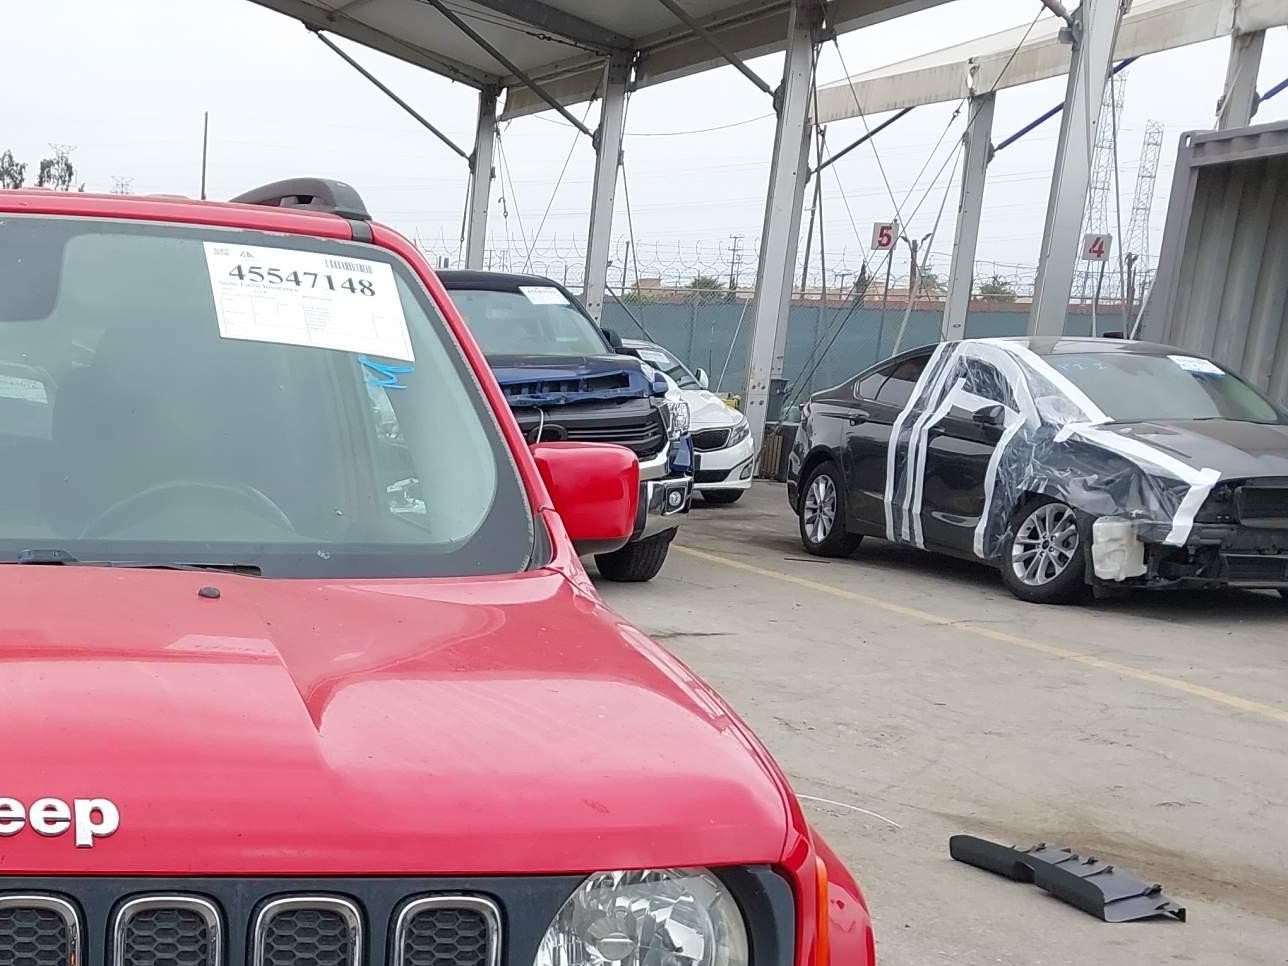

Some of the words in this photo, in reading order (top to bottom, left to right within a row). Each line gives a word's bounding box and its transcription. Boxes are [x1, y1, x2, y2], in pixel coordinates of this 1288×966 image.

[877, 225, 893, 247] 5
[1088, 236, 1105, 258] 4
[228, 263, 376, 298] 45547148
